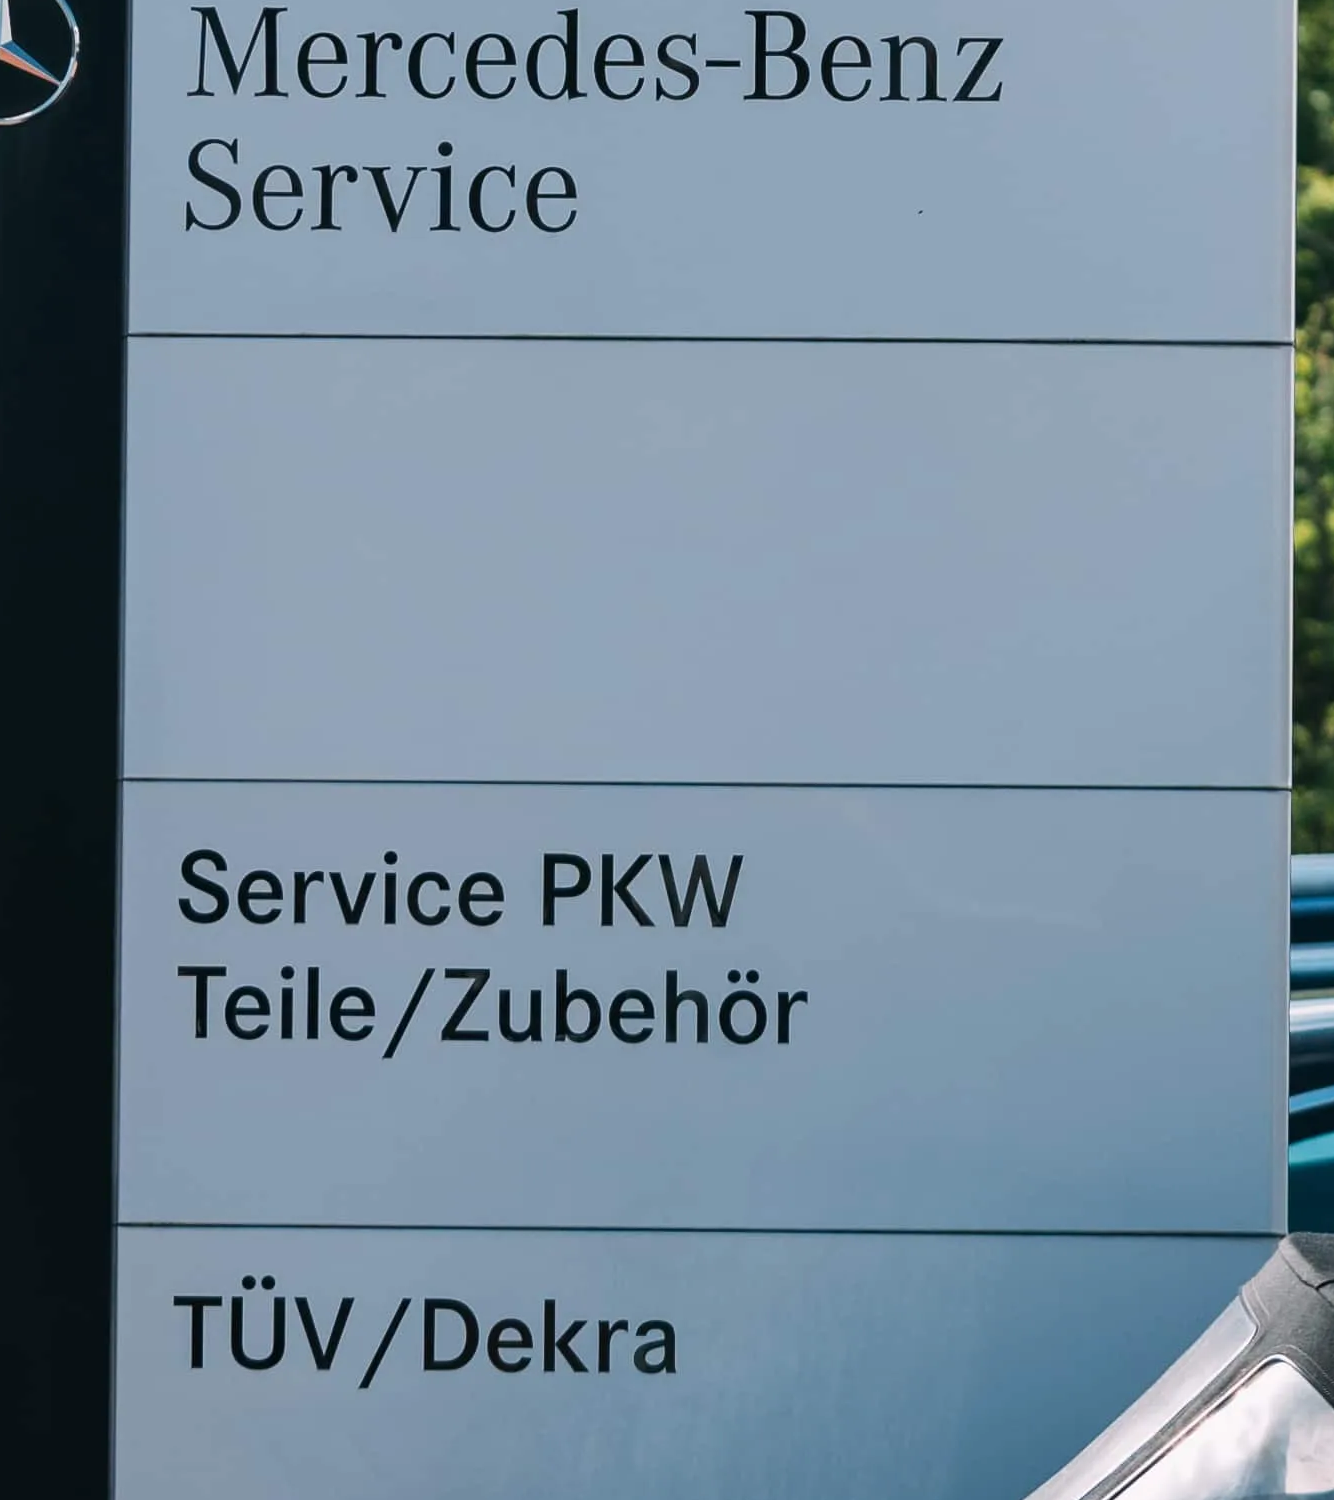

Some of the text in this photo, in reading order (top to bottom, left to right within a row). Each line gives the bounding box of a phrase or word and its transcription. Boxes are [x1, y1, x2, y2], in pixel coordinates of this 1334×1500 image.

[187, 6, 1004, 102] Mercedes-Benz
[185, 138, 578, 233] Service
[178, 848, 744, 928] Service PKW
[177, 965, 809, 1060] Teile/Zubehör
[173, 1274, 678, 1390] TÜV/Dekra
